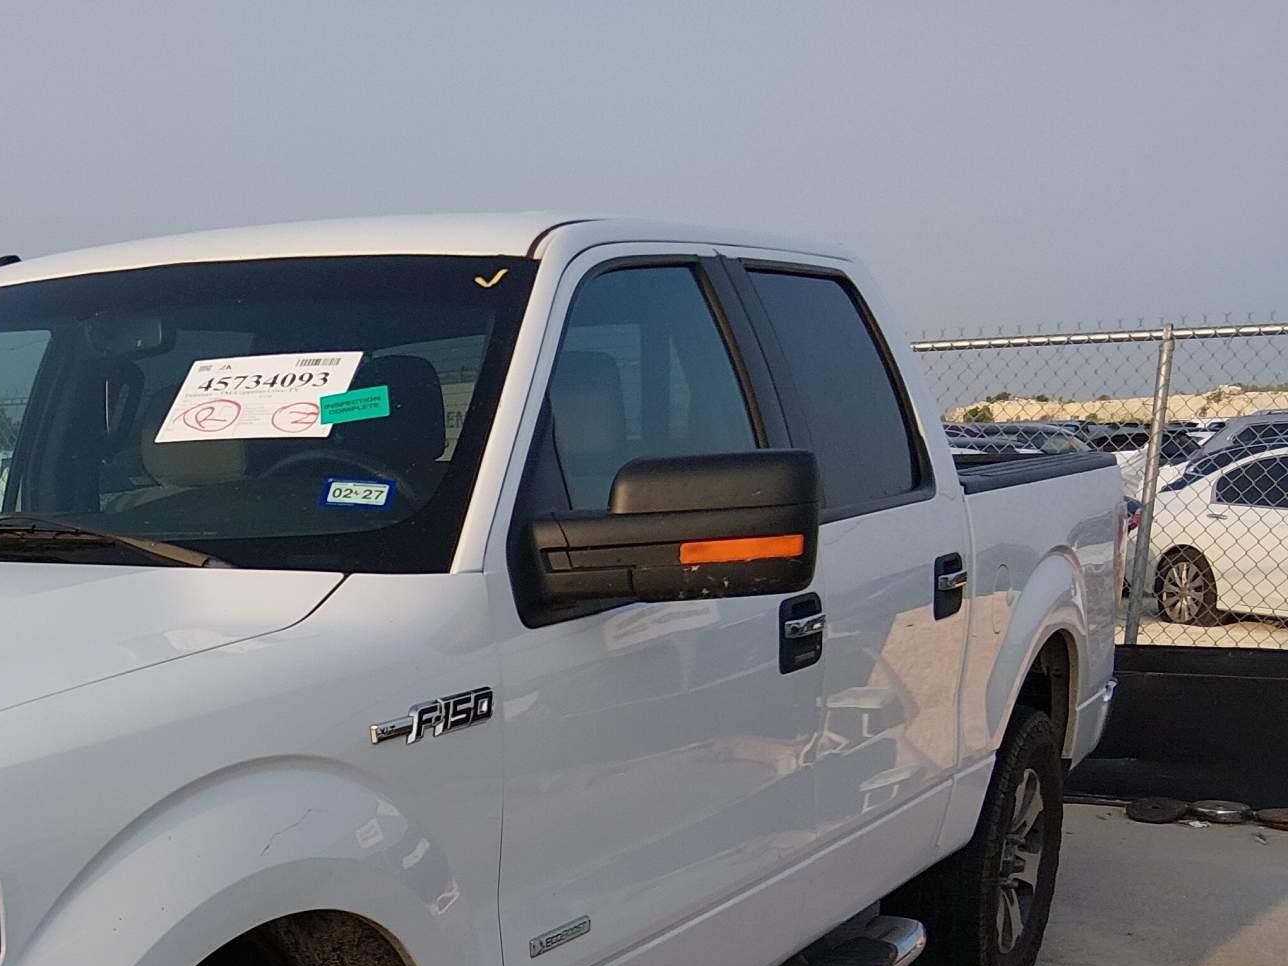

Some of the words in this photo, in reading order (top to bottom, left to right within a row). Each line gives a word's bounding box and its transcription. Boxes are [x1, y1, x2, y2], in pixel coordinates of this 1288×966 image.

[198, 371, 330, 392] 45734093
[324, 395, 381, 409] INSPECTION
[328, 402, 379, 415] COMPLETE
